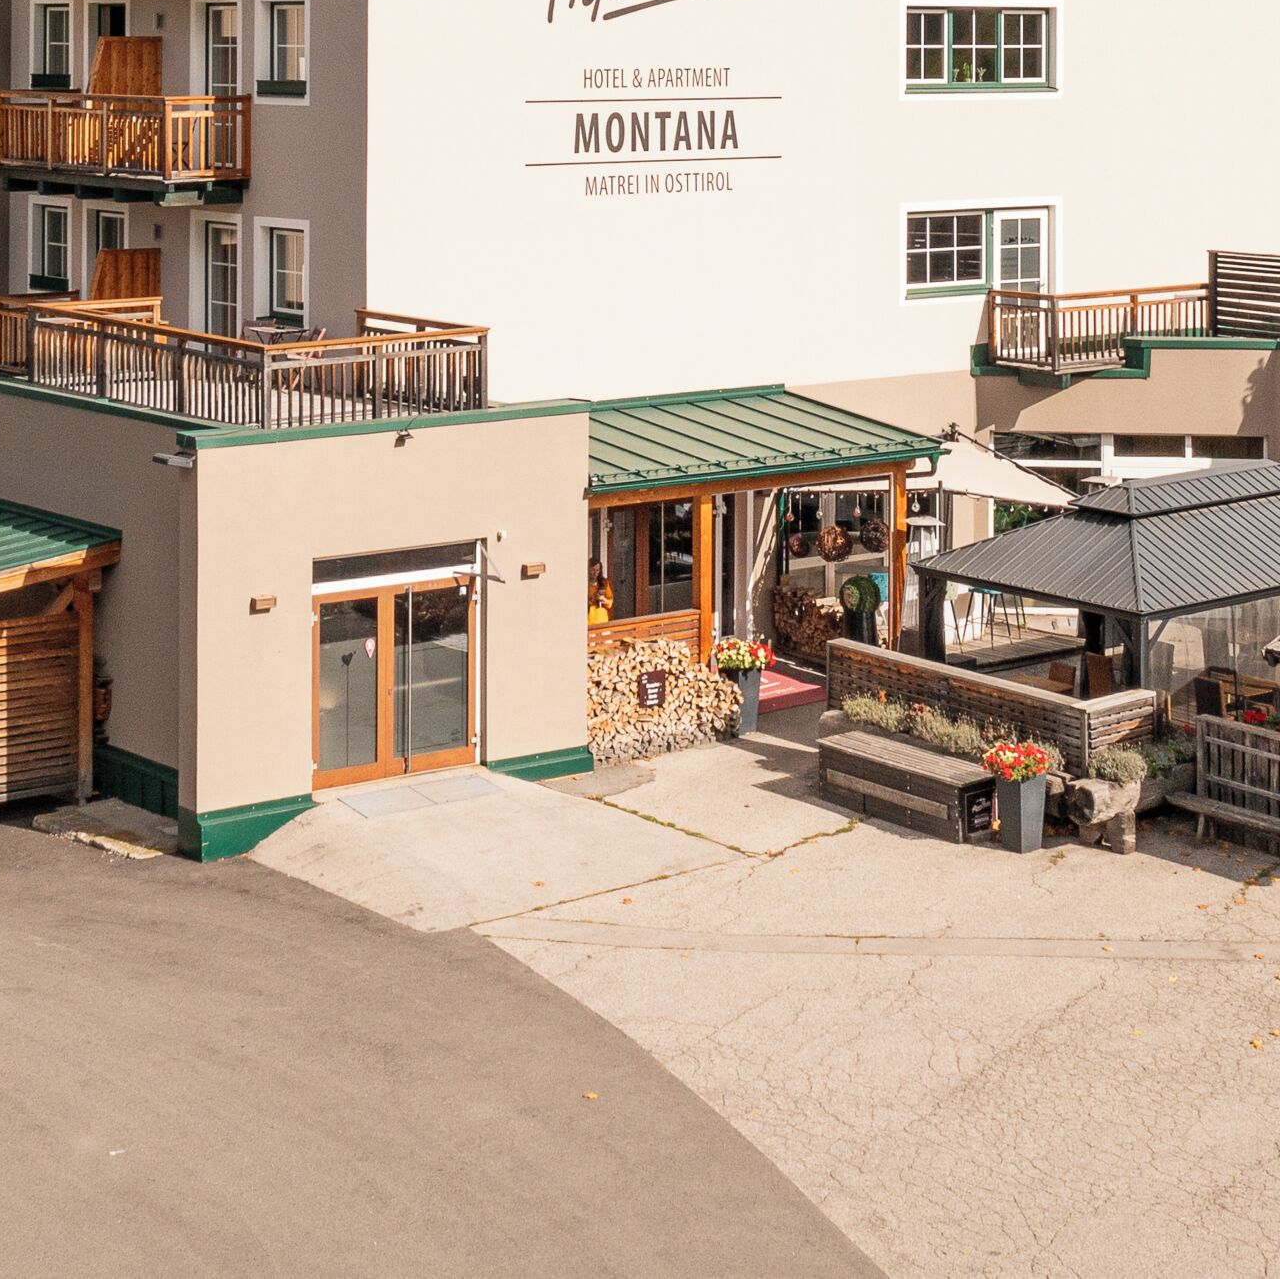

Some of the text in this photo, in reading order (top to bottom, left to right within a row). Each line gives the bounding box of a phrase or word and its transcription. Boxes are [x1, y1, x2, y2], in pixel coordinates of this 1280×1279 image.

[583, 67, 731, 89] HOTEL & APARTMENT
[574, 110, 739, 154] MONTANA
[585, 172, 733, 196] MATREI IN OSTTIROL
